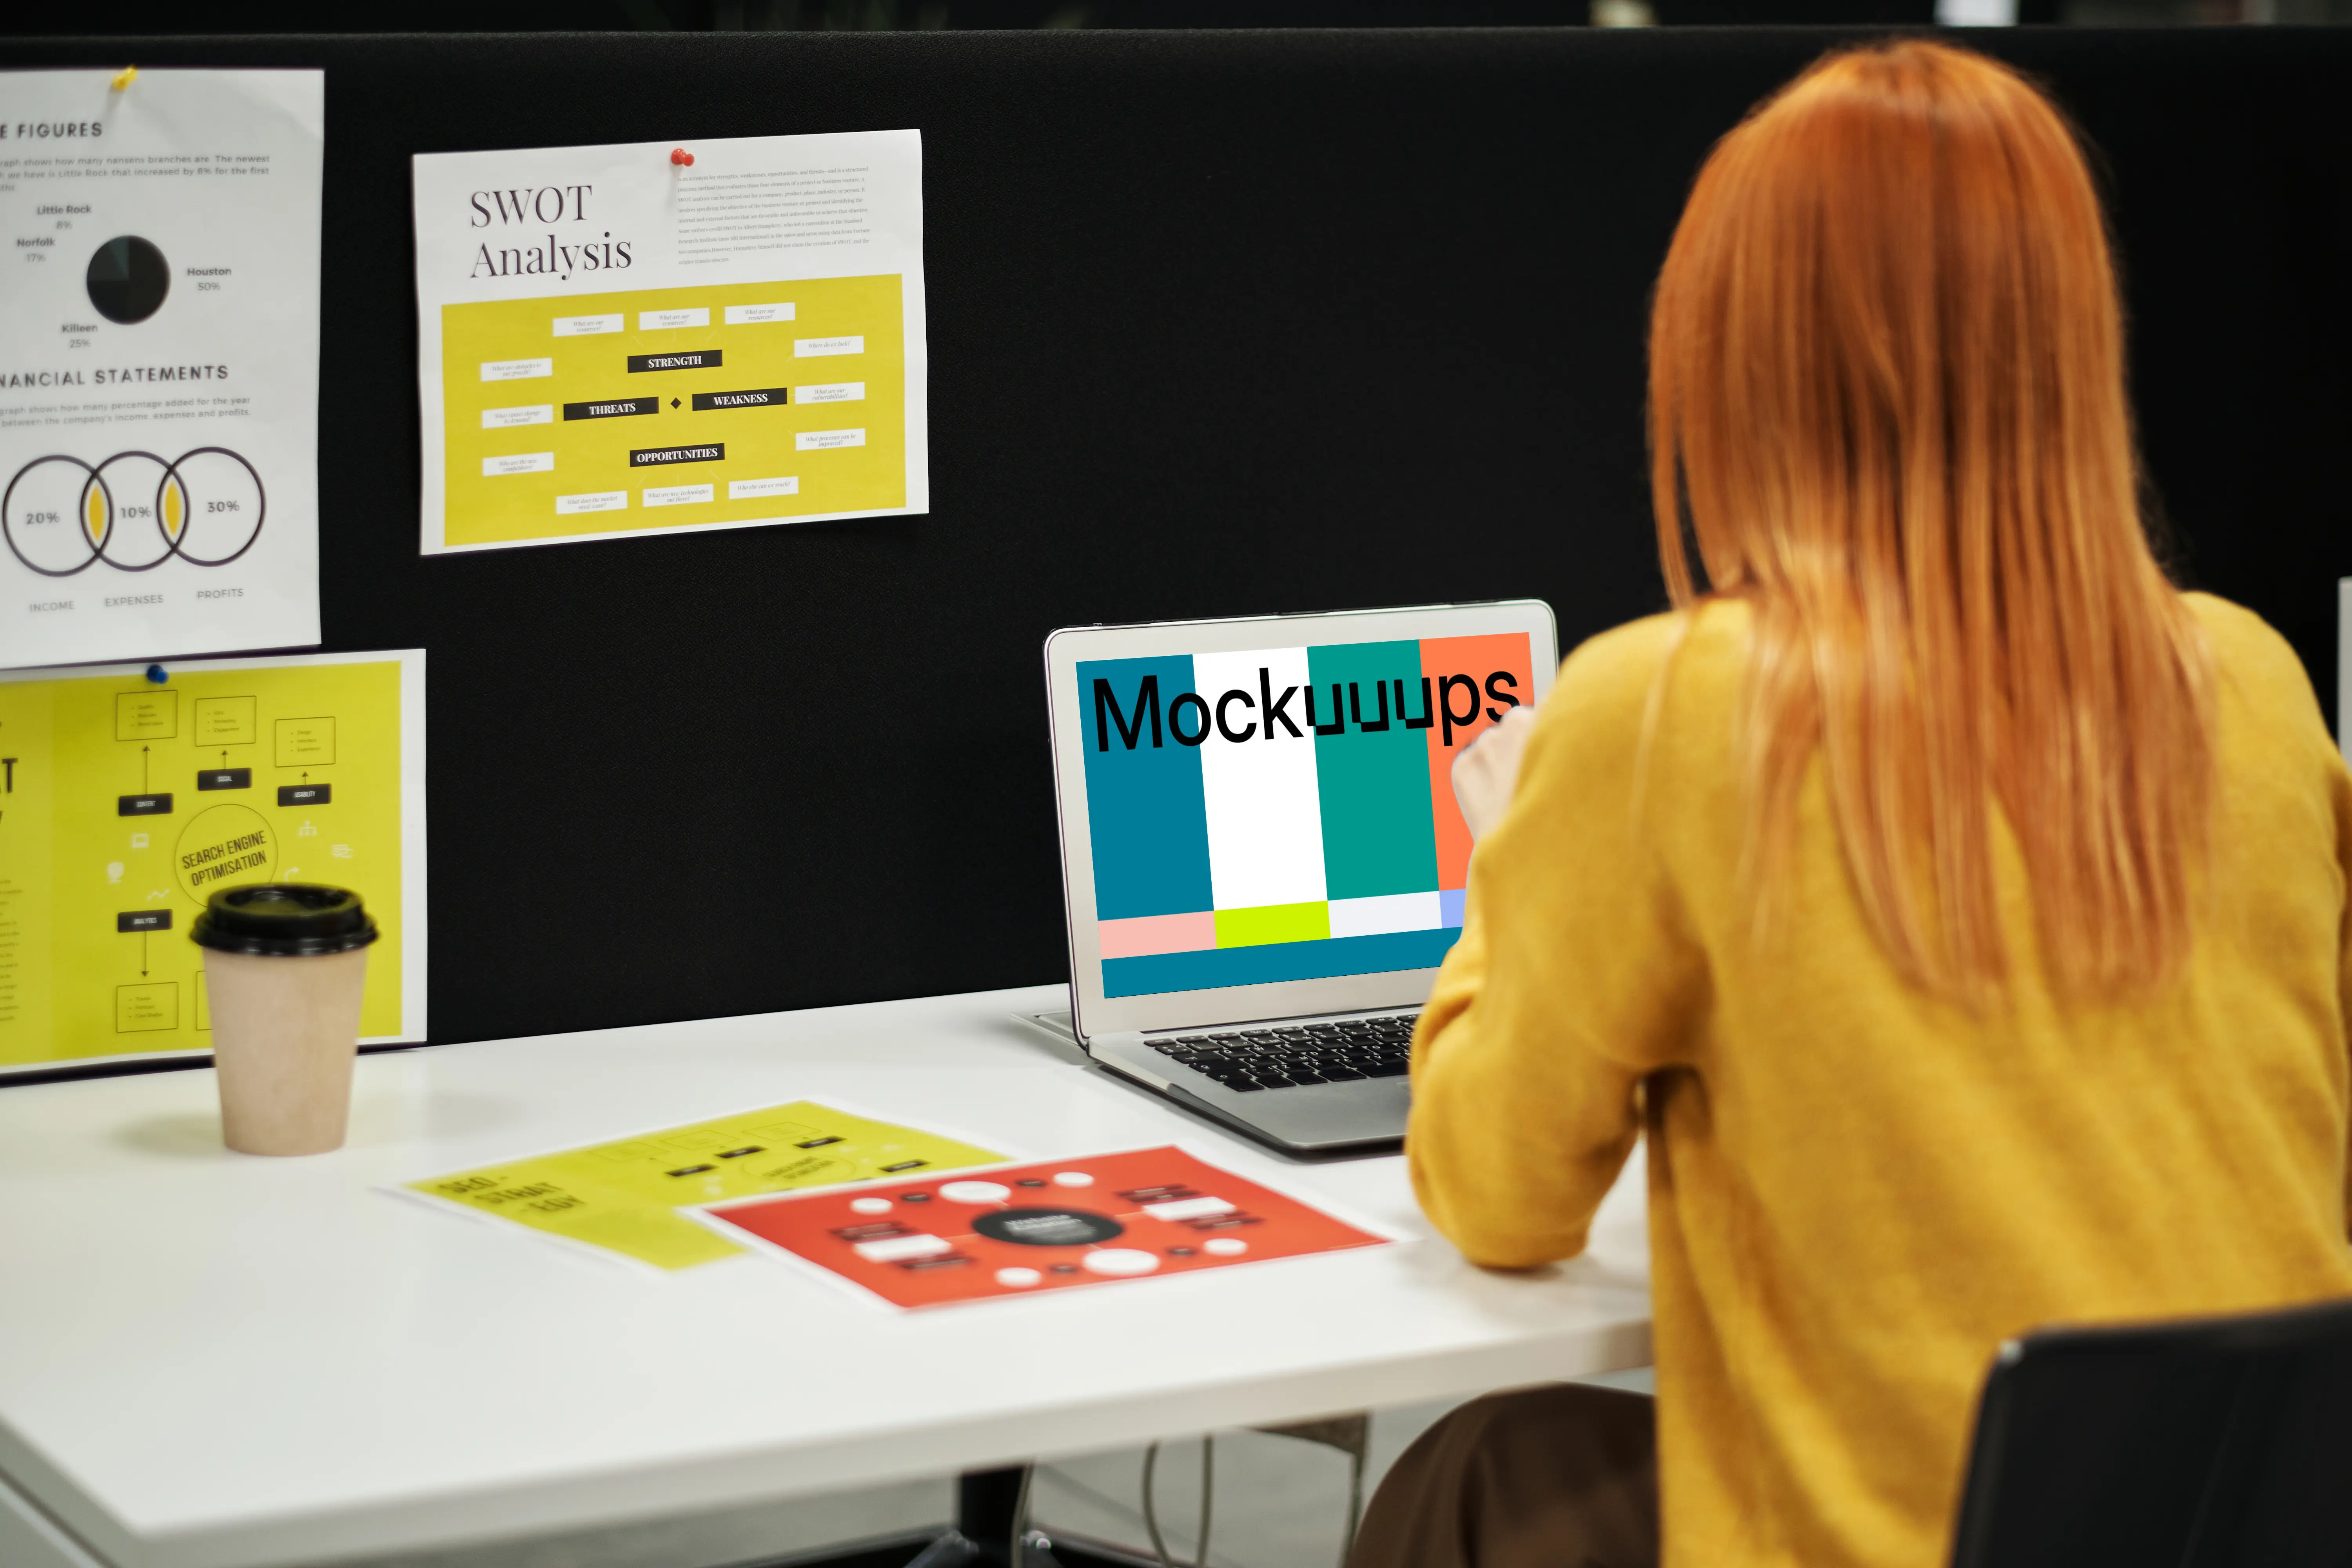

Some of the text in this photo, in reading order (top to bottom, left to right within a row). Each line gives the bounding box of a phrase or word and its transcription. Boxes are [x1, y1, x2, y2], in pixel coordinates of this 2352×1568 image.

[18, 123, 102, 137] FIGURES
[0, 160, 20, 168] raph
[182, 168, 194, 176] by
[37, 205, 91, 214] Little Rock
[471, 186, 592, 228] SWOT
[56, 221, 73, 229] 8%
[17, 238, 56, 247] Norfolk
[26, 253, 46, 262] 17%
[471, 232, 632, 280] Analysis
[198, 282, 220, 291] 50%
[62, 324, 98, 332] Killeen
[70, 339, 91, 348] 25%
[648, 356, 702, 368] STRENGTH
[95, 366, 228, 383] STATEMENTS
[713, 394, 768, 405] WEAKNESS
[111, 402, 162, 410] percentage
[589, 403, 636, 415] THREATS
[637, 448, 718, 462] OPPORTUNITIES
[208, 501, 240, 512] 30%
[121, 507, 151, 518] 10%
[27, 513, 59, 524] 20%
[197, 588, 243, 599] PROFITS
[105, 595, 163, 606] EXPENSES
[29, 601, 75, 612] INCOME
[1093, 667, 1520, 752] Mockuuups
[182, 830, 268, 870] SEARCH ENGINE
[191, 850, 268, 886] OPTIMISATION
